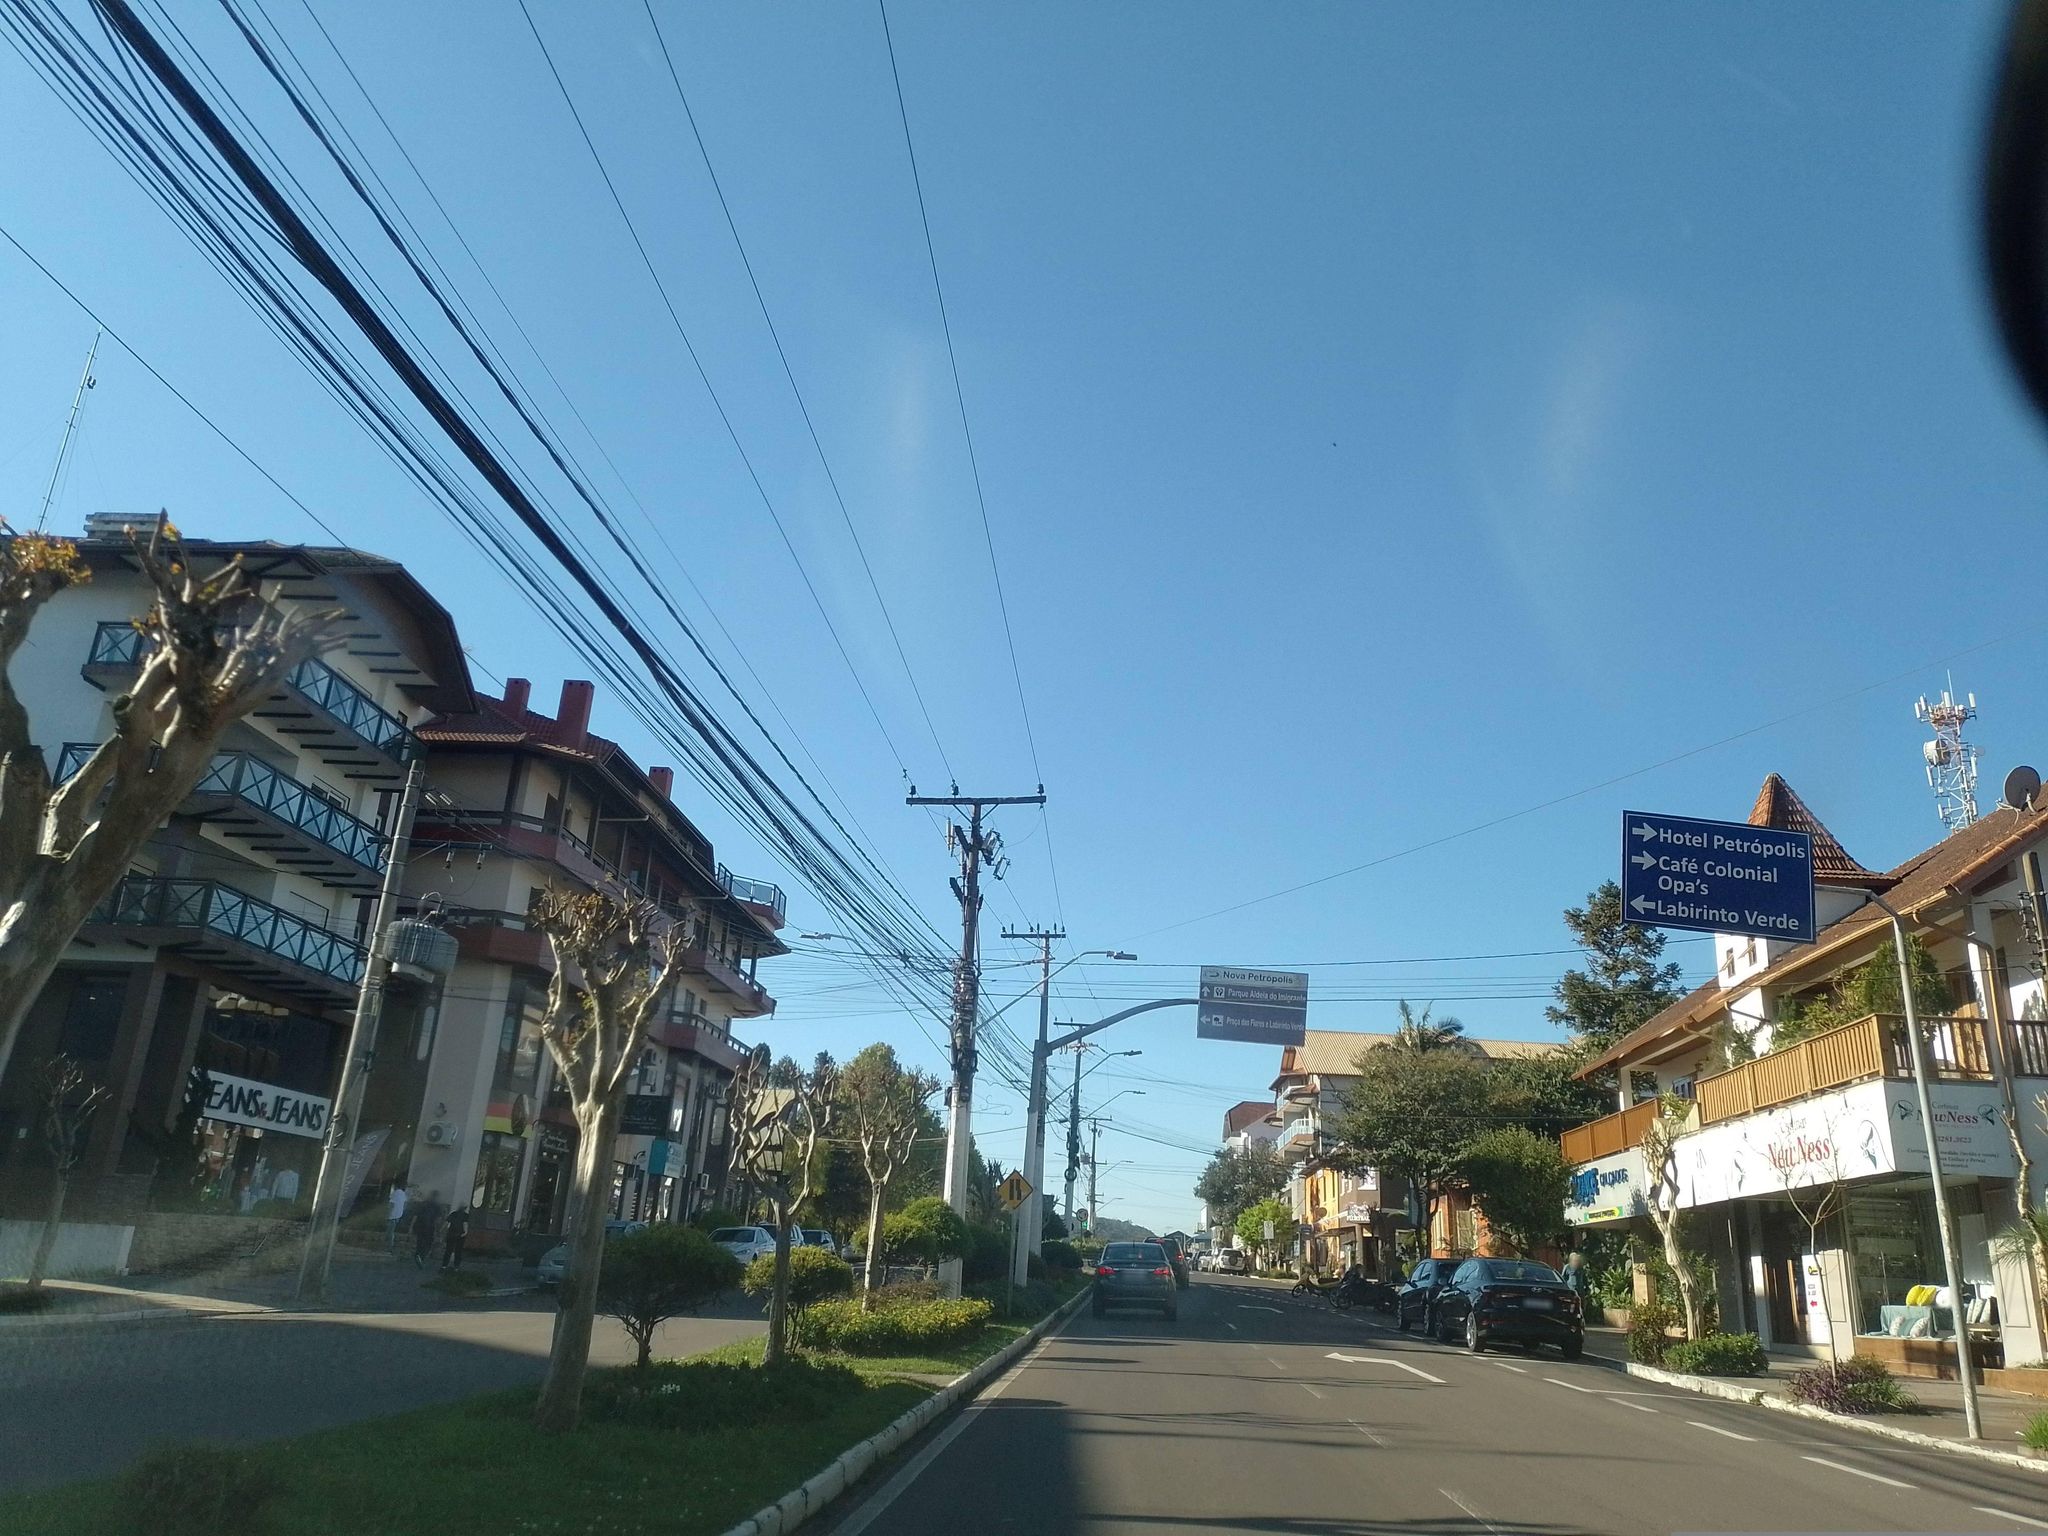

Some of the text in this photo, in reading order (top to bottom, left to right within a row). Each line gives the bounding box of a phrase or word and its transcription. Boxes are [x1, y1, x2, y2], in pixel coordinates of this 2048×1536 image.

[1659, 827, 1806, 859] Hotel Petrópolis
[1658, 855, 1778, 883] Café Colonial
[1658, 875, 1709, 896] Opa's
[1657, 900, 1799, 931] Labirinto Verde
[1223, 971, 1246, 980] Nova
[1228, 988, 1306, 1003] Parque Aldeia do Imigrante
[1226, 1016, 1241, 1027] Praça
[1916, 1110, 1979, 1124] NwNess
[1768, 1136, 1831, 1169] NewNess
